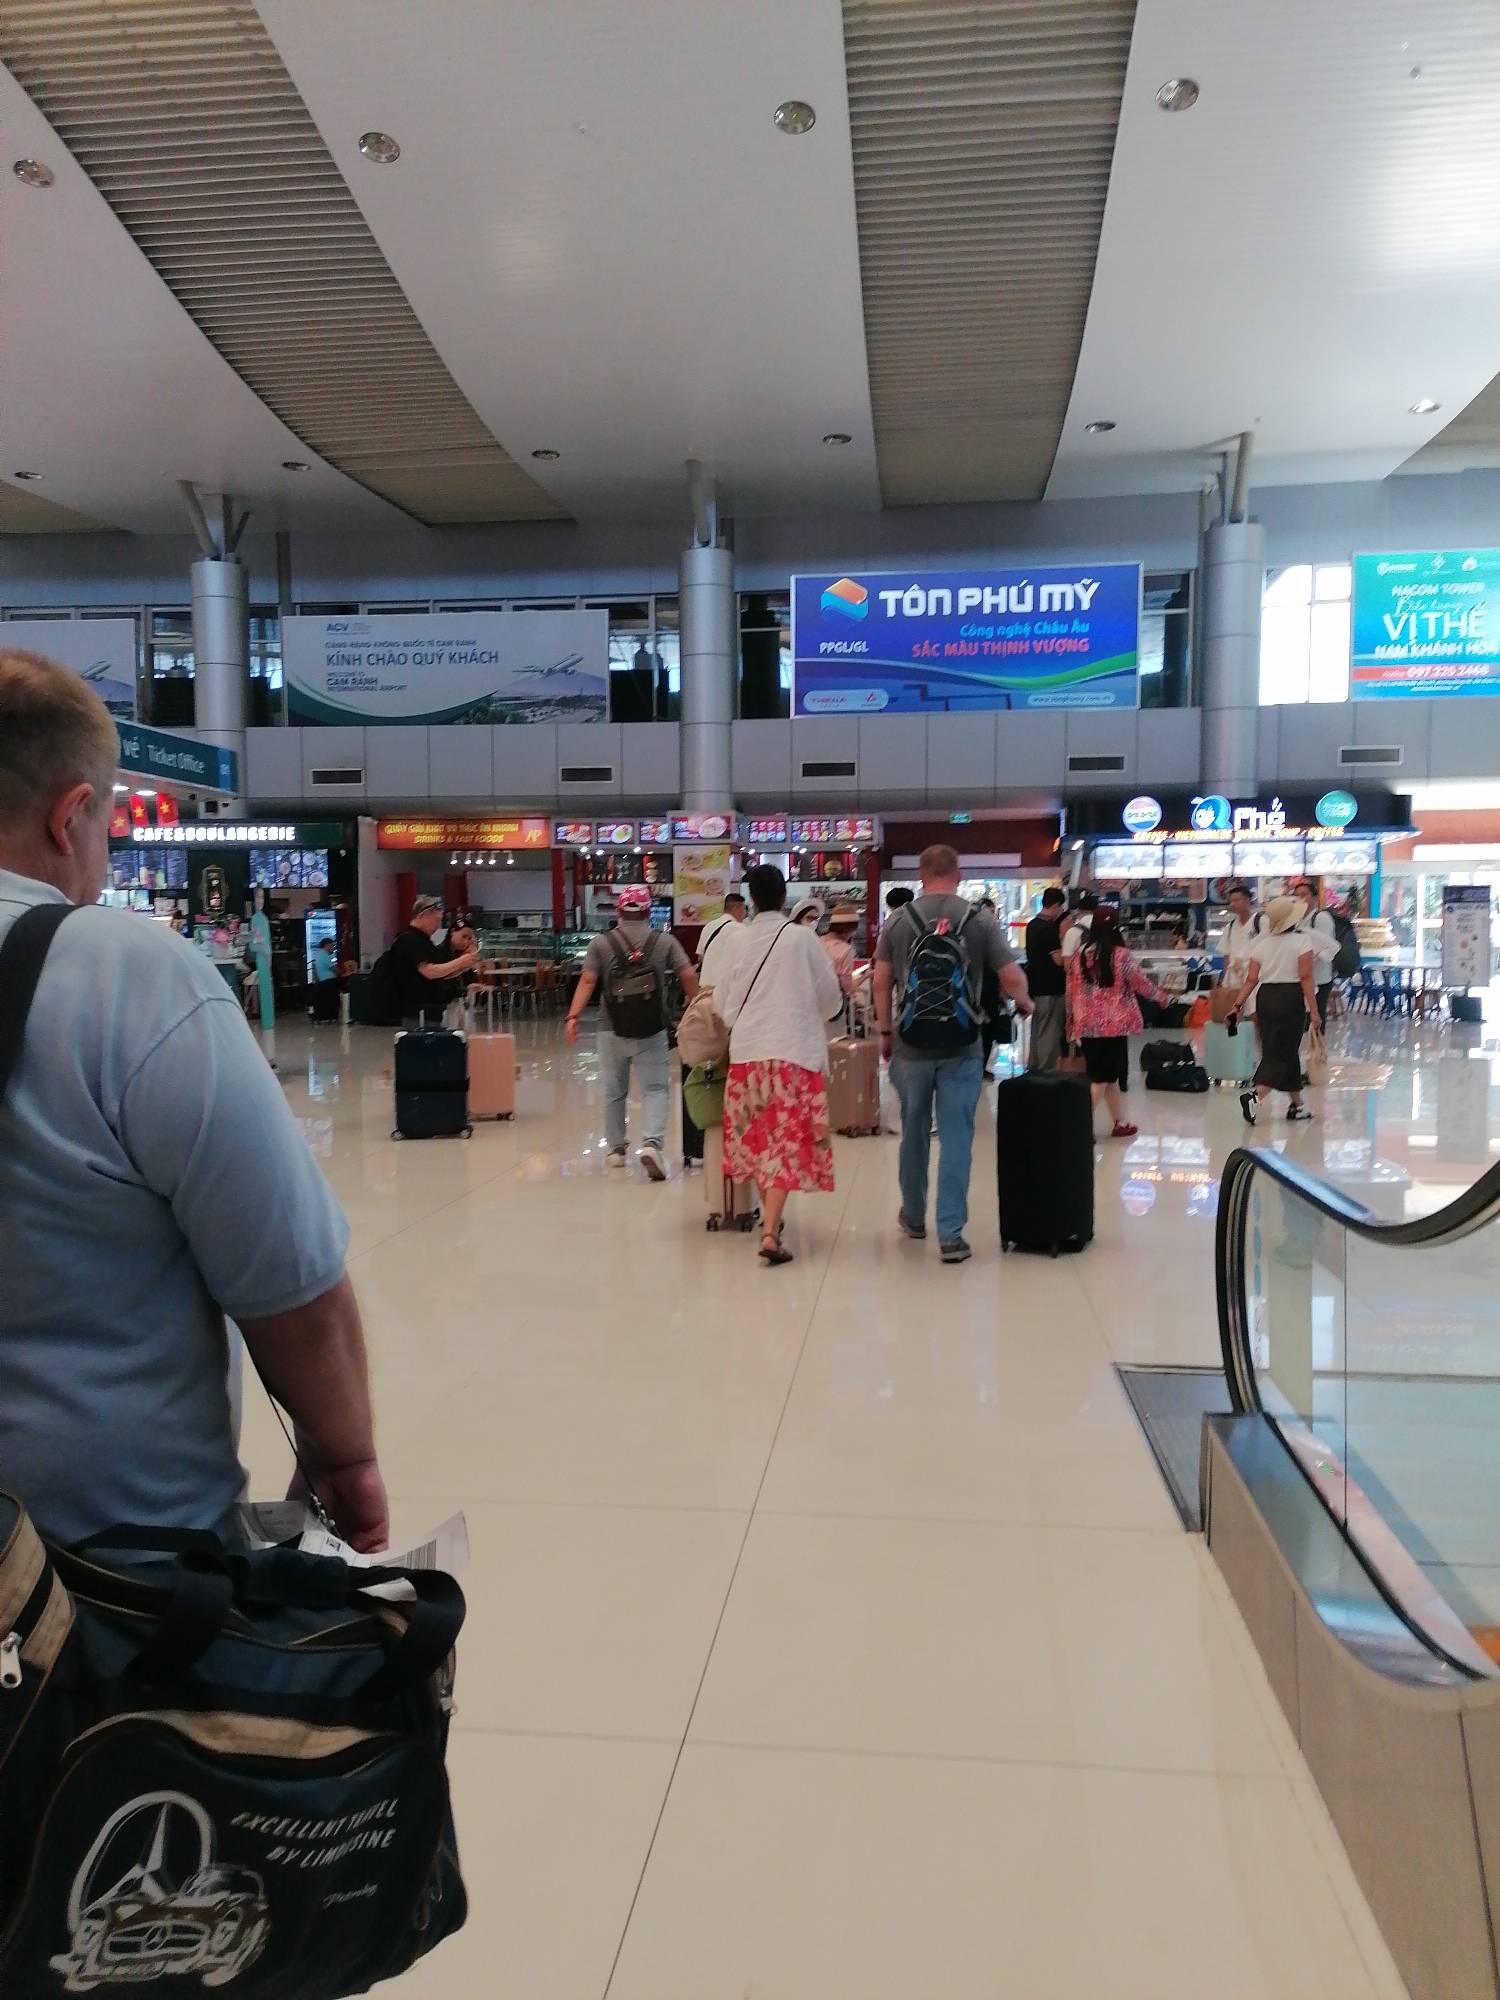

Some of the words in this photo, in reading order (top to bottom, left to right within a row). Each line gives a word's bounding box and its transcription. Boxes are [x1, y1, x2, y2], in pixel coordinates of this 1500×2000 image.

[878, 583, 952, 618] TÔN
[957, 580, 1034, 616] PHÚ
[1039, 578, 1101, 612] MỸ
[960, 623, 994, 639] Công
[997, 621, 1031, 638] nghệ
[1033, 620, 1069, 635] Châu
[1071, 618, 1091, 634] Âu
[326, 651, 362, 666] KÍNH
[366, 650, 409, 666] CHÀO
[412, 649, 443, 667] QUÝ
[448, 648, 500, 665] KHÁCH
[819, 641, 869, 654] PPGL/GL
[912, 640, 940, 658] SẮC
[943, 639, 979, 656] MÀU
[982, 639, 1029, 658] THỊNH
[1032, 638, 1090, 657] VƯỢNG
[326, 677, 347, 686] CAM
[350, 677, 378, 686] RANH
[147, 744, 177, 768] Ticket
[177, 752, 205, 774] Office
[414, 835, 447, 844] DRINKS
[455, 835, 473, 843] FAST
[475, 834, 505, 844] FOODS
[230, 1812, 349, 1839] EXCELLENT
[266, 1845, 301, 1865] BY
[300, 1829, 397, 1869] LIMOUSINE
